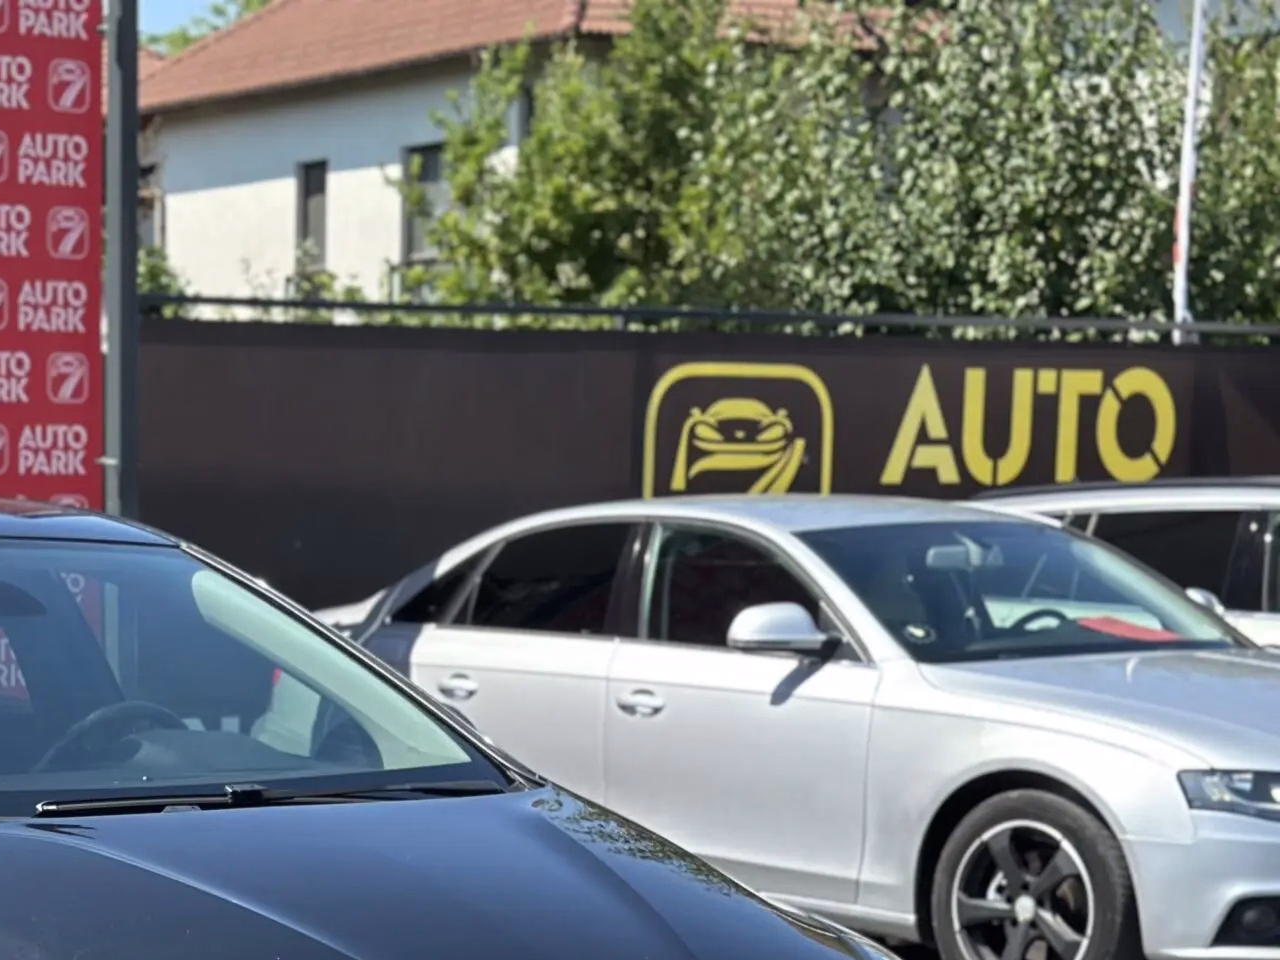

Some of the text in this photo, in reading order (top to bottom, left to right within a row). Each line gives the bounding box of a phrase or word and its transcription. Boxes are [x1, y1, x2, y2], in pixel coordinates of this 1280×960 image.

[18, 9, 89, 40] PARK
[17, 132, 88, 162] AUTO
[18, 157, 86, 188] PARK
[17, 280, 87, 306] AUTO
[17, 305, 85, 333] PARK
[18, 424, 88, 450] AUTO
[880, 364, 1177, 486] AUTO
[18, 449, 86, 475] PARK
